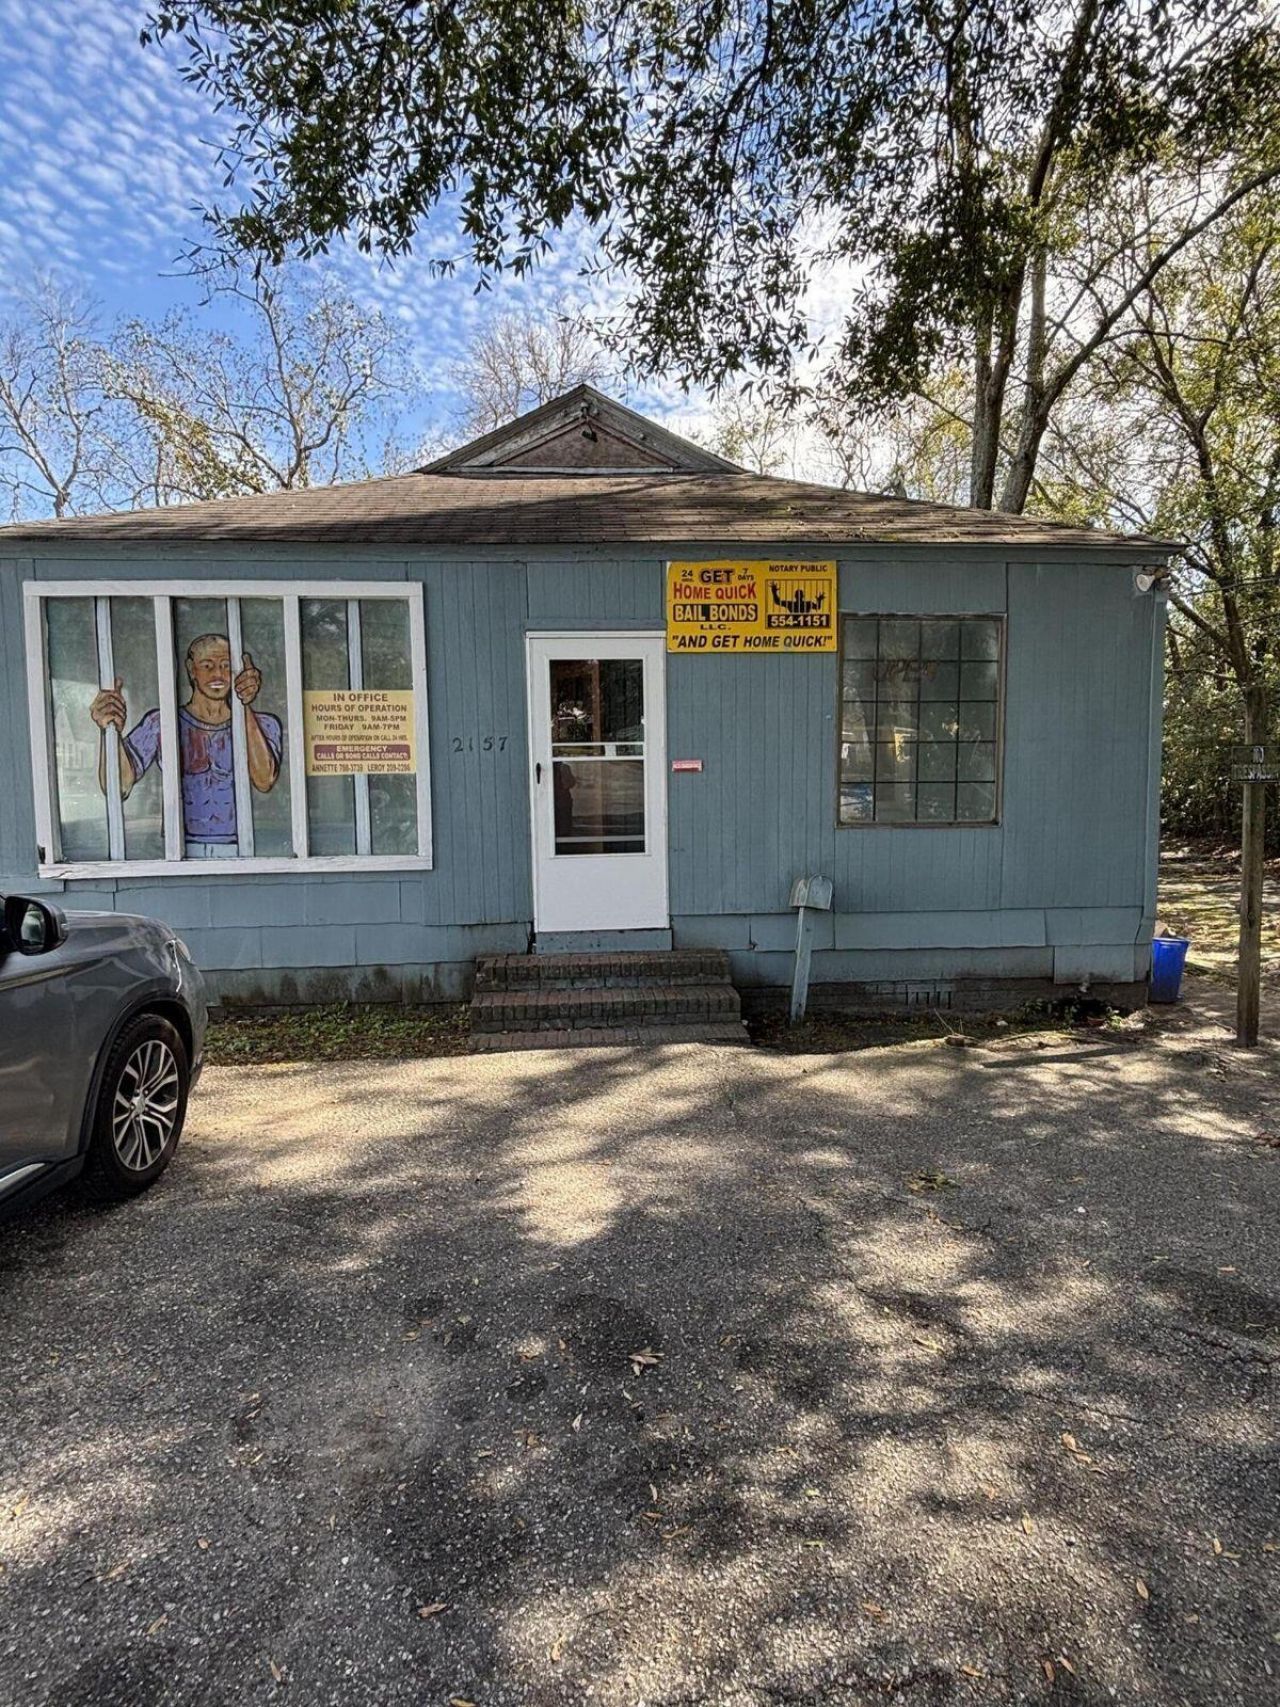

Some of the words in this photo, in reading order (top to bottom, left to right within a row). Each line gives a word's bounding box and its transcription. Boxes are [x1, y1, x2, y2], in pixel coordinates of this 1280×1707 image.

[681, 570, 693, 578] 24
[769, 564, 798, 572] NOTARY
[801, 564, 828, 572] PUBLIC
[700, 569, 735, 584] GET
[673, 582, 711, 600] HOME
[716, 582, 757, 600] QUICK
[675, 604, 706, 621] BAIL
[709, 604, 756, 621] BONDS
[770, 615, 827, 627] 554-1151
[712, 635, 740, 648] GET
[743, 635, 779, 648] HOME
[333, 693, 345, 702] IN
[348, 693, 388, 702] OFFICE
[311, 704, 342, 712] HOURS
[344, 704, 354, 712] OF
[358, 704, 407, 712] OPERATION
[452, 737, 508, 752] 2157
